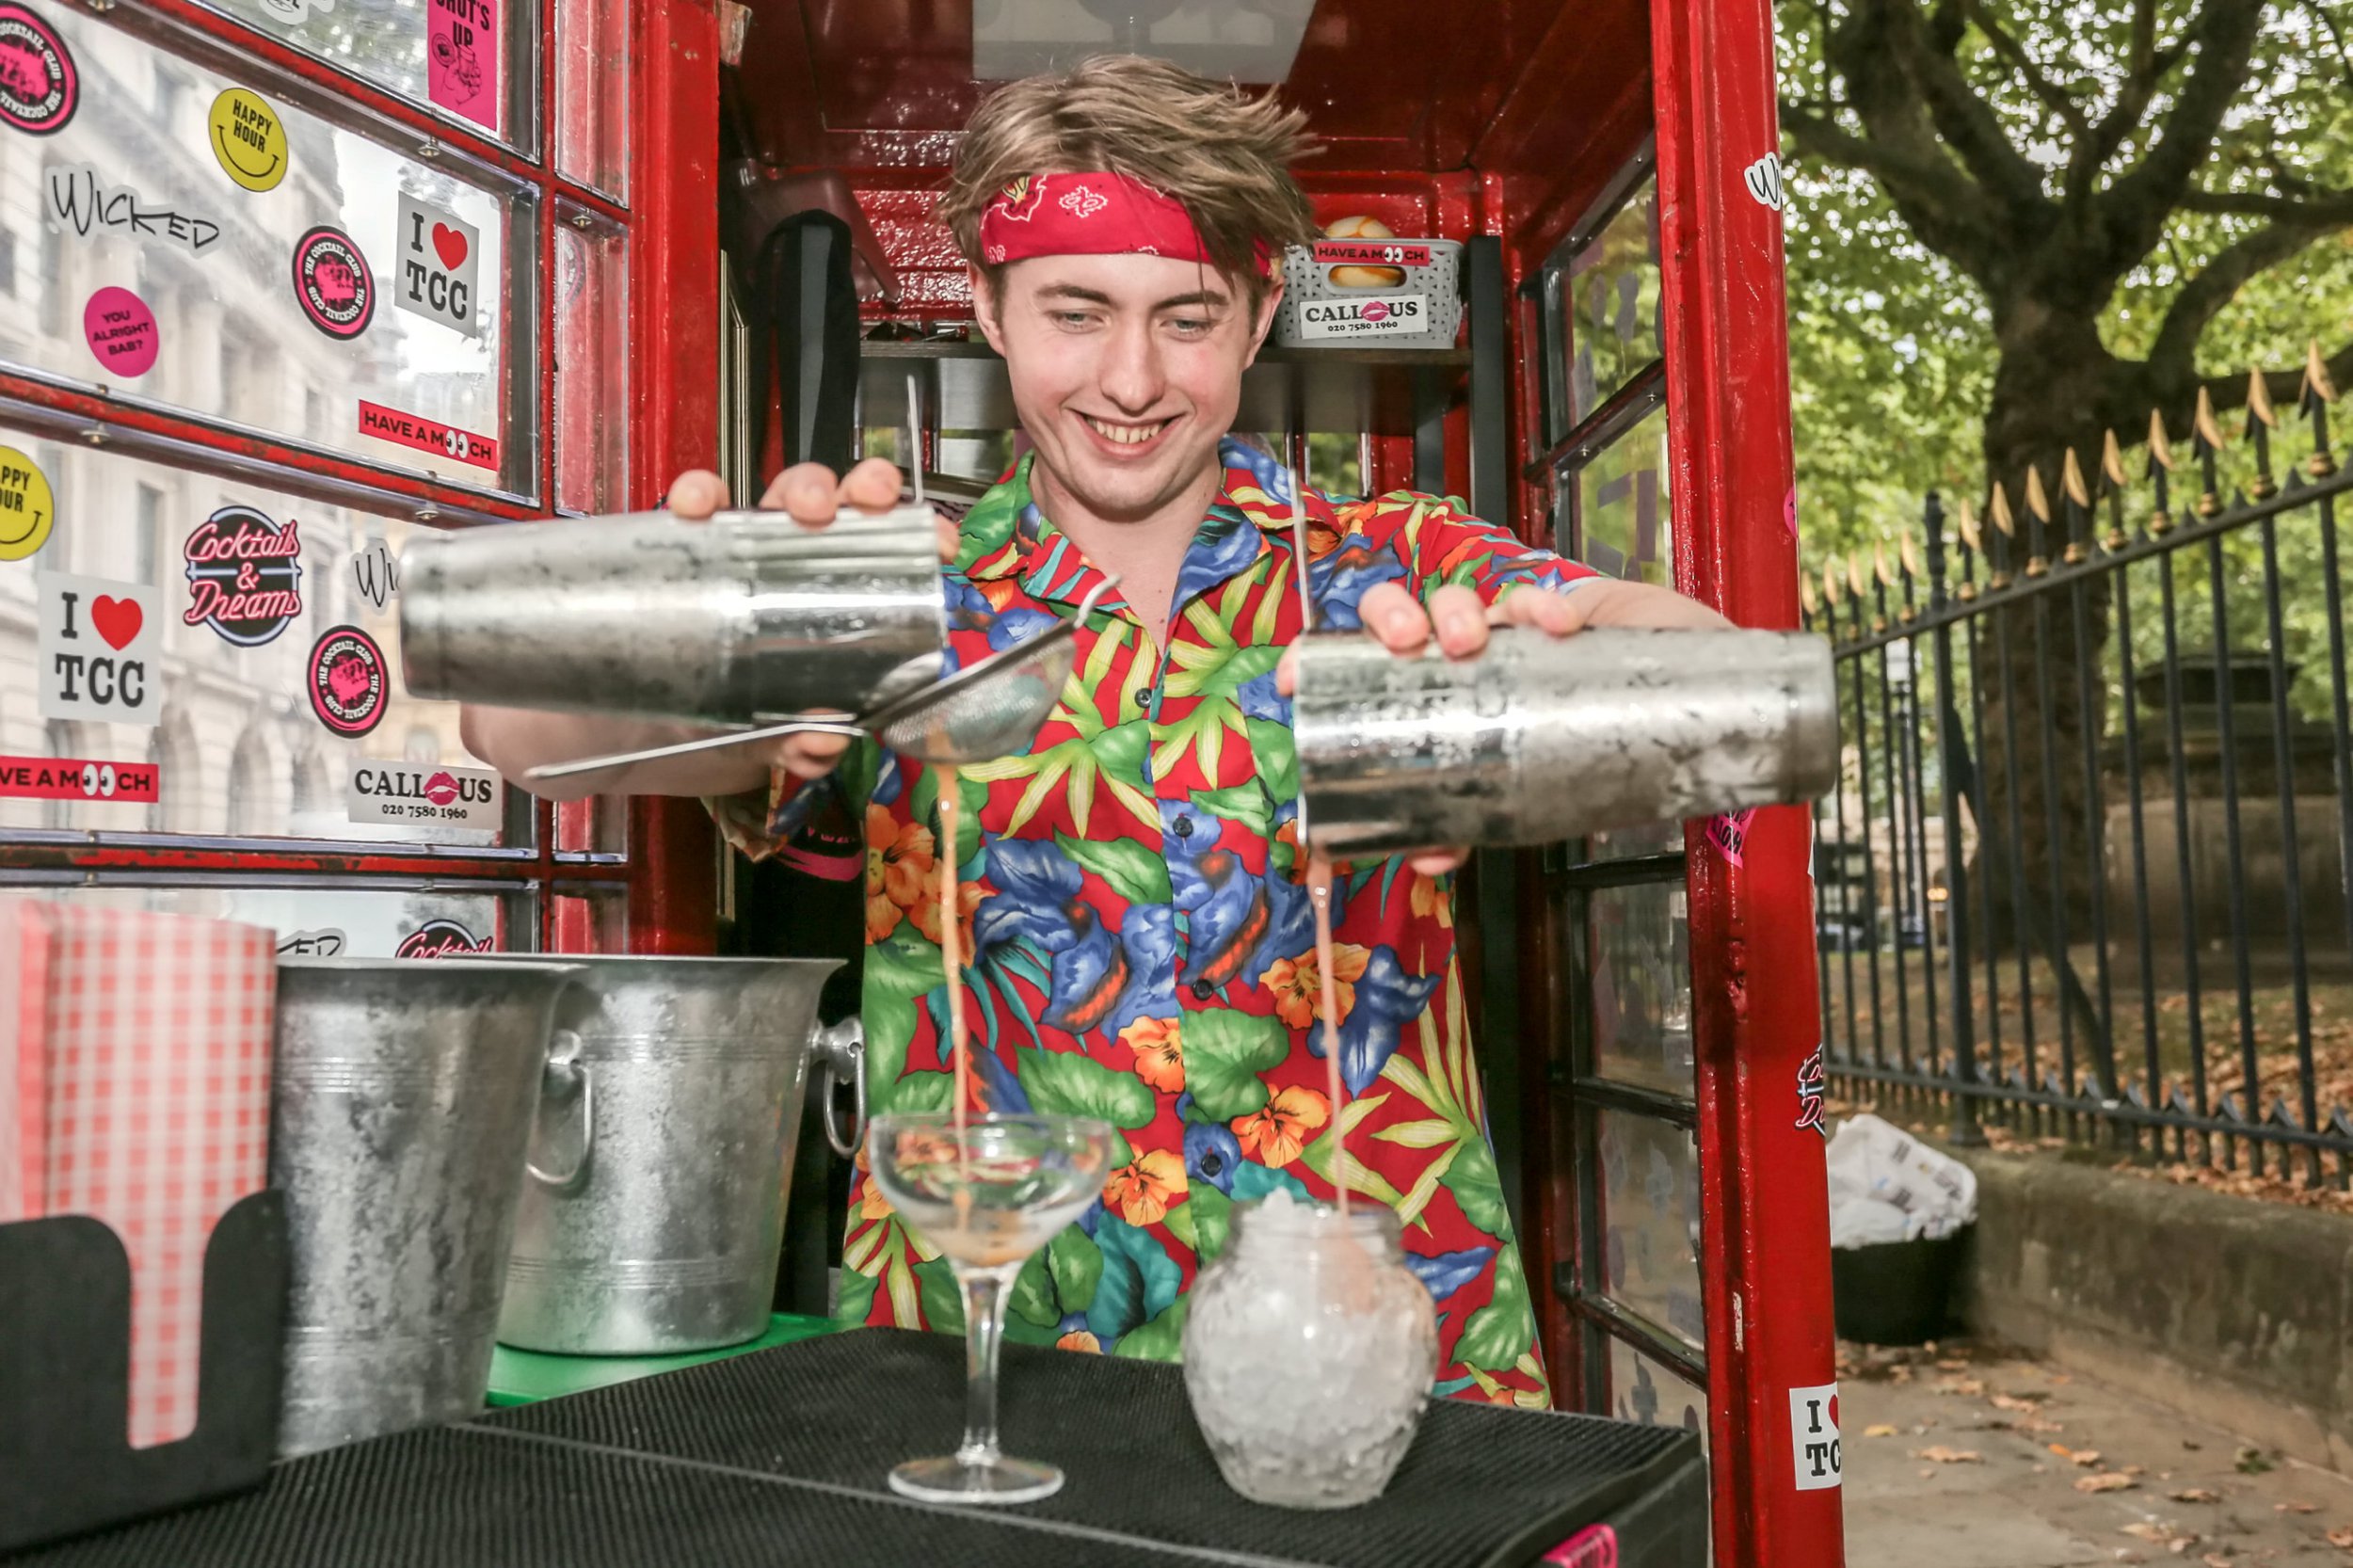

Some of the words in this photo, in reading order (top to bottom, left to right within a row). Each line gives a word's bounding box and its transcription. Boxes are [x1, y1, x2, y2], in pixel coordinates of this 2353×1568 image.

[436, 0, 489, 31] HUT'S
[232, 98, 272, 136] HAPPY
[233, 120, 265, 153] HOUR
[53, 170, 219, 249] WICKED
[411, 211, 424, 253] I
[304, 256, 315, 276] THE
[311, 241, 345, 257] COCKTAIL
[345, 253, 361, 277] CLUB
[1319, 247, 1355, 258] HAVE
[1359, 248, 1369, 259] A
[308, 286, 326, 311] CLUB
[355, 287, 365, 307] THE
[406, 259, 468, 321] TCC
[102, 310, 130, 324] YOU
[326, 305, 360, 321] COCKTAIL
[1305, 305, 1364, 323] CALL
[1388, 301, 1417, 317] US
[93, 322, 150, 342] ALRIGHT
[1348, 323, 1372, 331] 7580
[1375, 321, 1398, 329] 1960
[107, 340, 143, 356] BAB?
[364, 410, 412, 438] HAVE
[415, 426, 427, 442] A
[185, 520, 300, 562] Cocktails
[236, 562, 260, 591] &
[355, 548, 400, 608] WI
[184, 579, 302, 623] Dreams
[61, 591, 78, 640] I
[322, 640, 355, 664] COCKTAIL
[355, 644, 374, 664] CLUB
[55, 652, 144, 708] TCC
[318, 665, 328, 686] THE
[370, 674, 379, 694] THE
[325, 695, 344, 715] CLUB
[344, 695, 376, 719] COCKTAIL
[37, 768, 55, 787] A
[355, 769, 427, 798] CALL
[457, 776, 492, 803] US
[382, 804, 404, 815] 020
[408, 806, 437, 818] 7580
[440, 808, 468, 820] 1960
[1806, 1399, 1823, 1433] I
